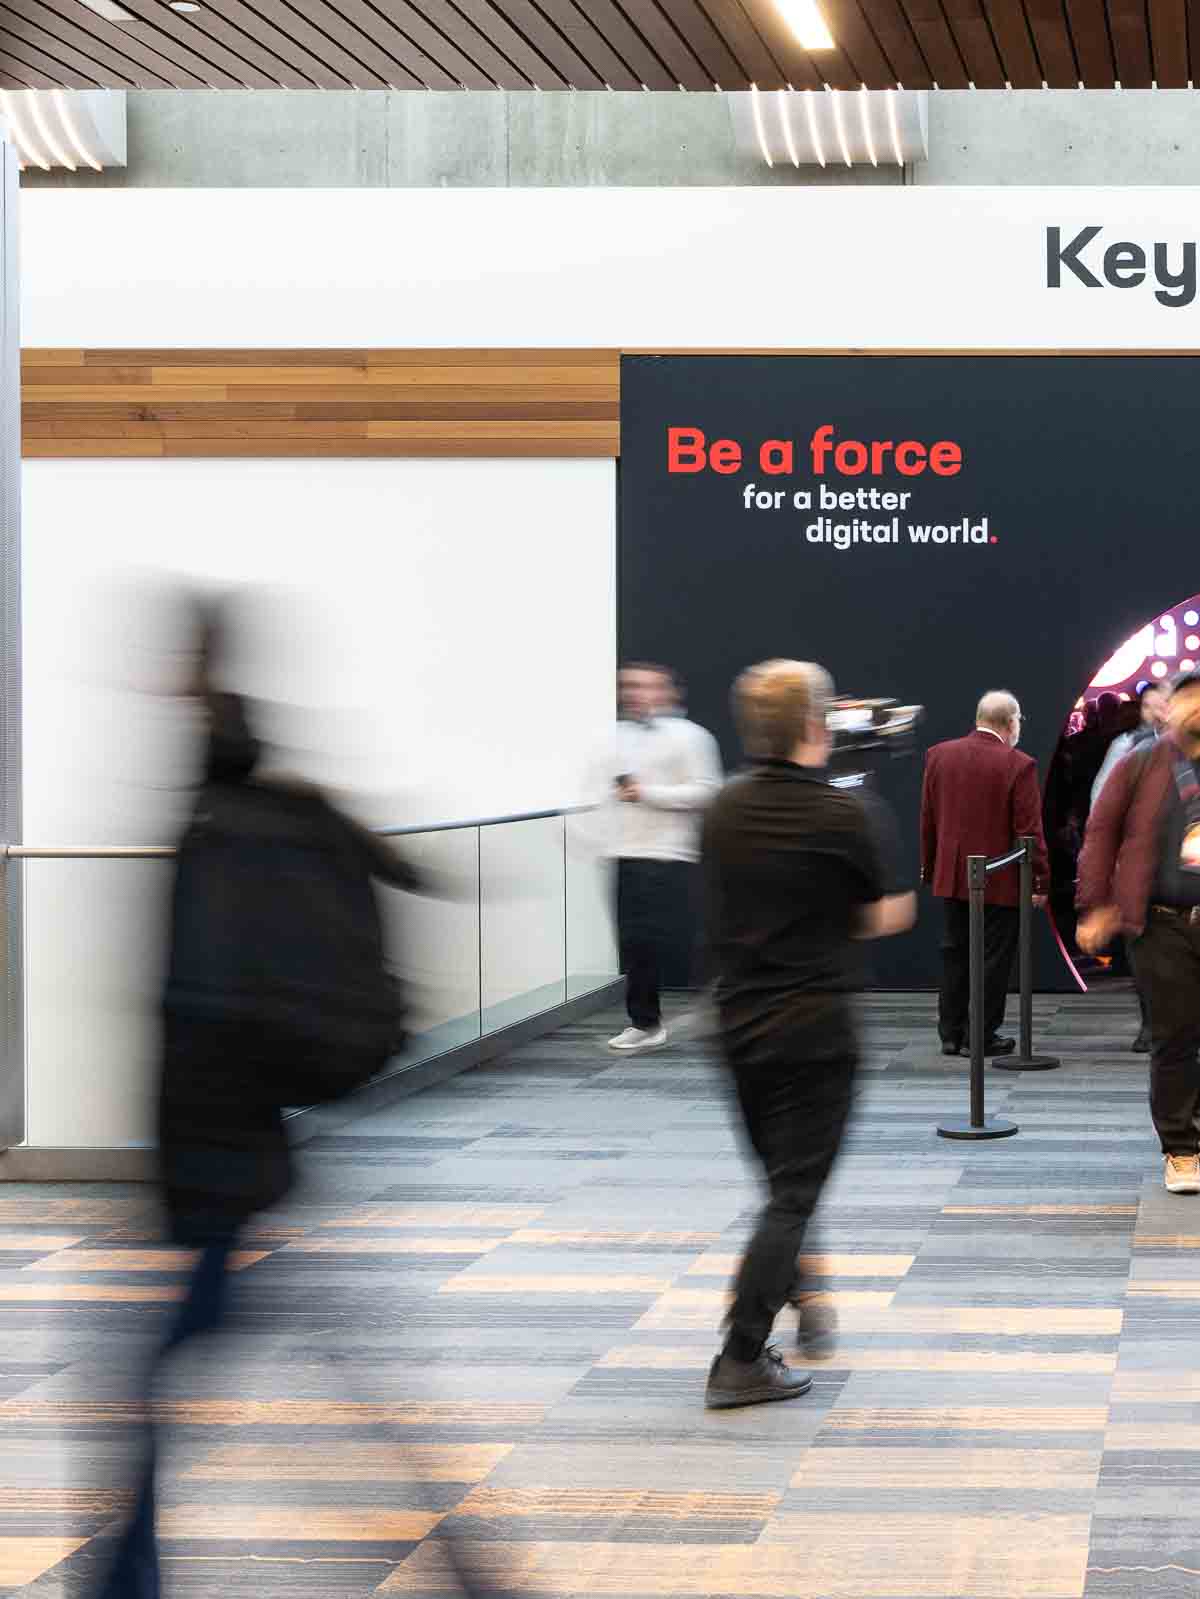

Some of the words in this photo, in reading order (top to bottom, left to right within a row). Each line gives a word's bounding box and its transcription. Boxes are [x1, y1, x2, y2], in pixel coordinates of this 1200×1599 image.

[667, 427, 742, 475] Be
[759, 439, 793, 475] a
[810, 424, 962, 476] force
[743, 483, 786, 510] for
[793, 490, 812, 510] a
[819, 484, 911, 511] better
[805, 517, 899, 550] digital
[907, 518, 998, 544] world.
